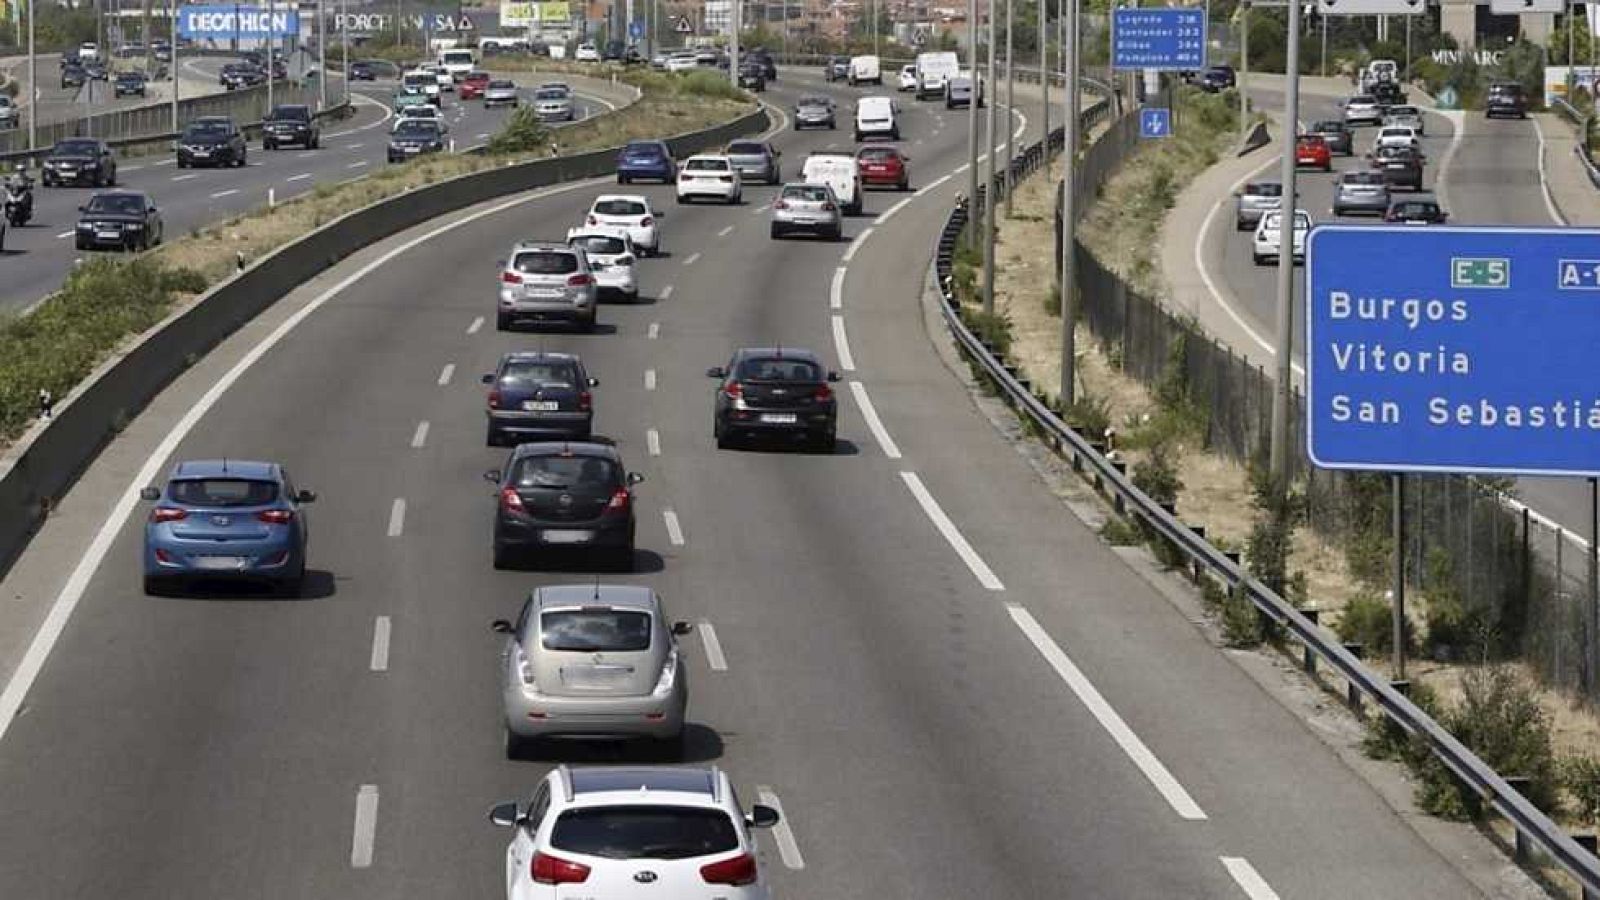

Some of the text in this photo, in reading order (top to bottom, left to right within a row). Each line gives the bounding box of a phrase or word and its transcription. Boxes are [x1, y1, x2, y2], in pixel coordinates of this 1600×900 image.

[187, 12, 287, 32] DECATHLON
[1455, 260, 1506, 285] E-5
[1329, 291, 1468, 329] Burgos
[1331, 342, 1470, 374] Vitoria
[1331, 395, 1400, 424] San
